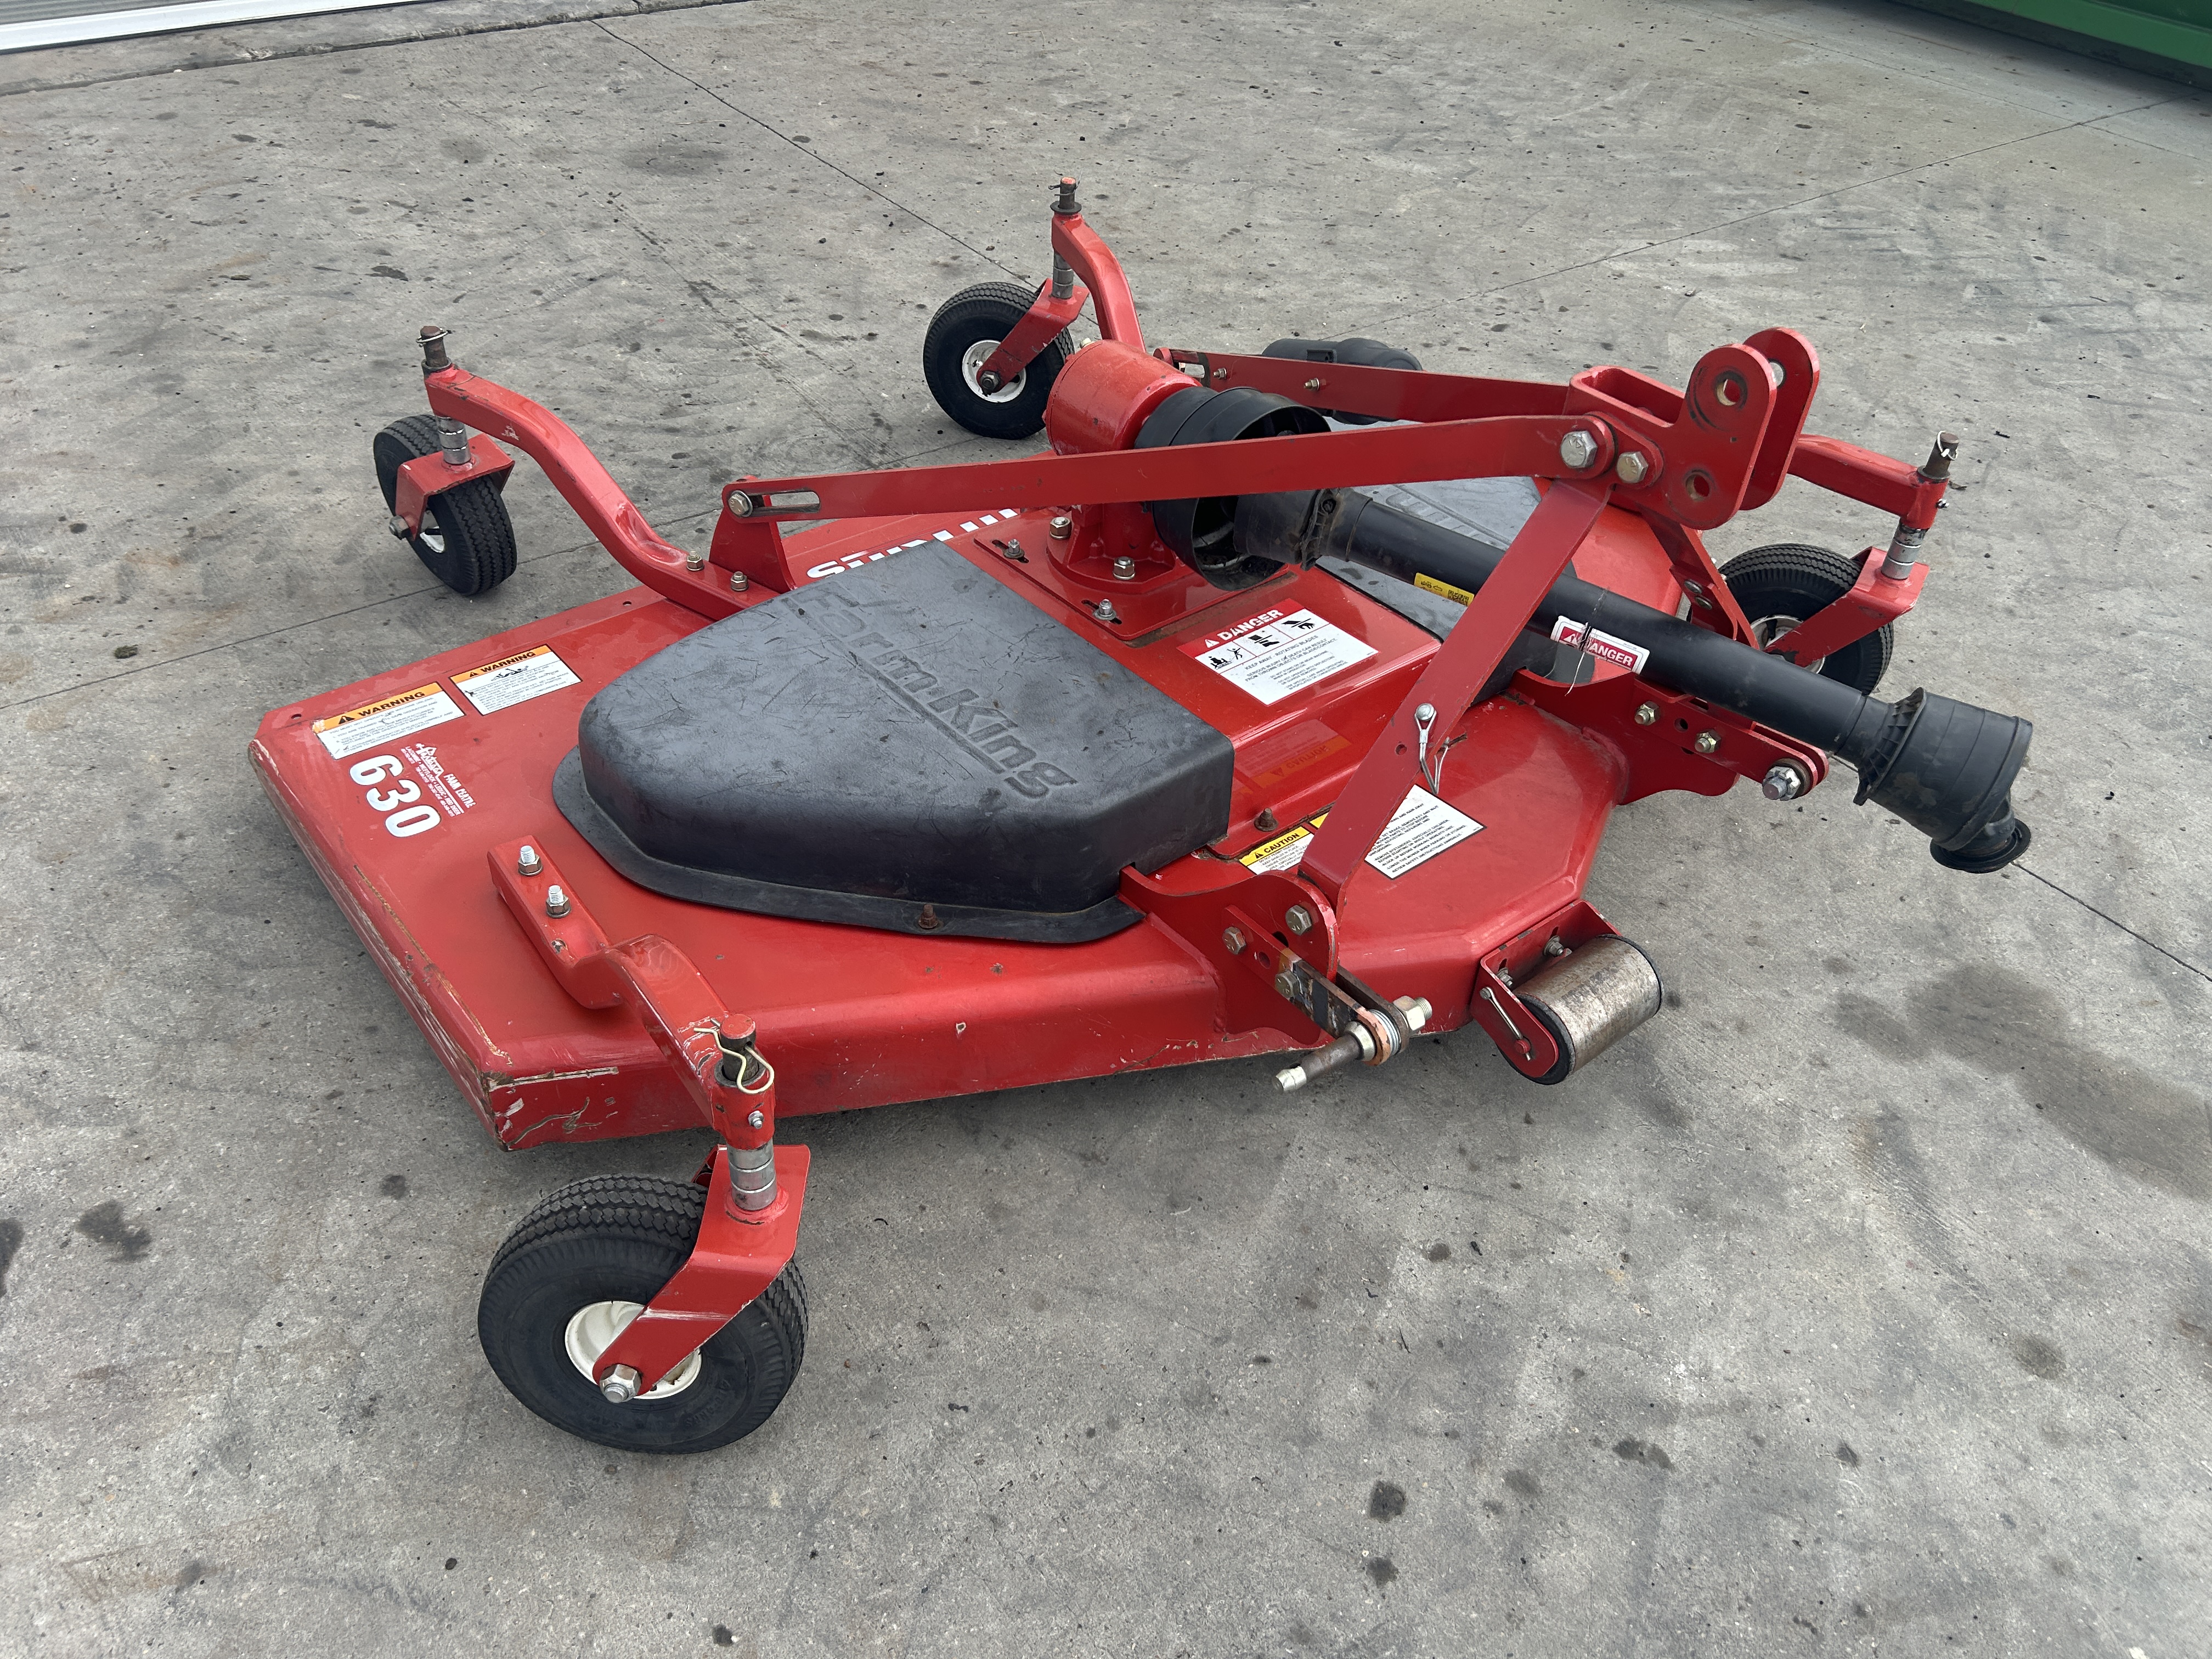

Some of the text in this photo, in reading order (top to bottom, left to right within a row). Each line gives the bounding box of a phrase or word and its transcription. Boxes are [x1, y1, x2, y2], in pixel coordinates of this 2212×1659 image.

[1217, 608, 1284, 641] DANGER
[483, 651, 536, 674] WARNING
[1274, 644, 1299, 656] ROTATING
[1585, 641, 1634, 667] ANGER
[358, 690, 425, 718] WARNING
[349, 754, 442, 838] 630
[1263, 833, 1300, 853] CAUTION
